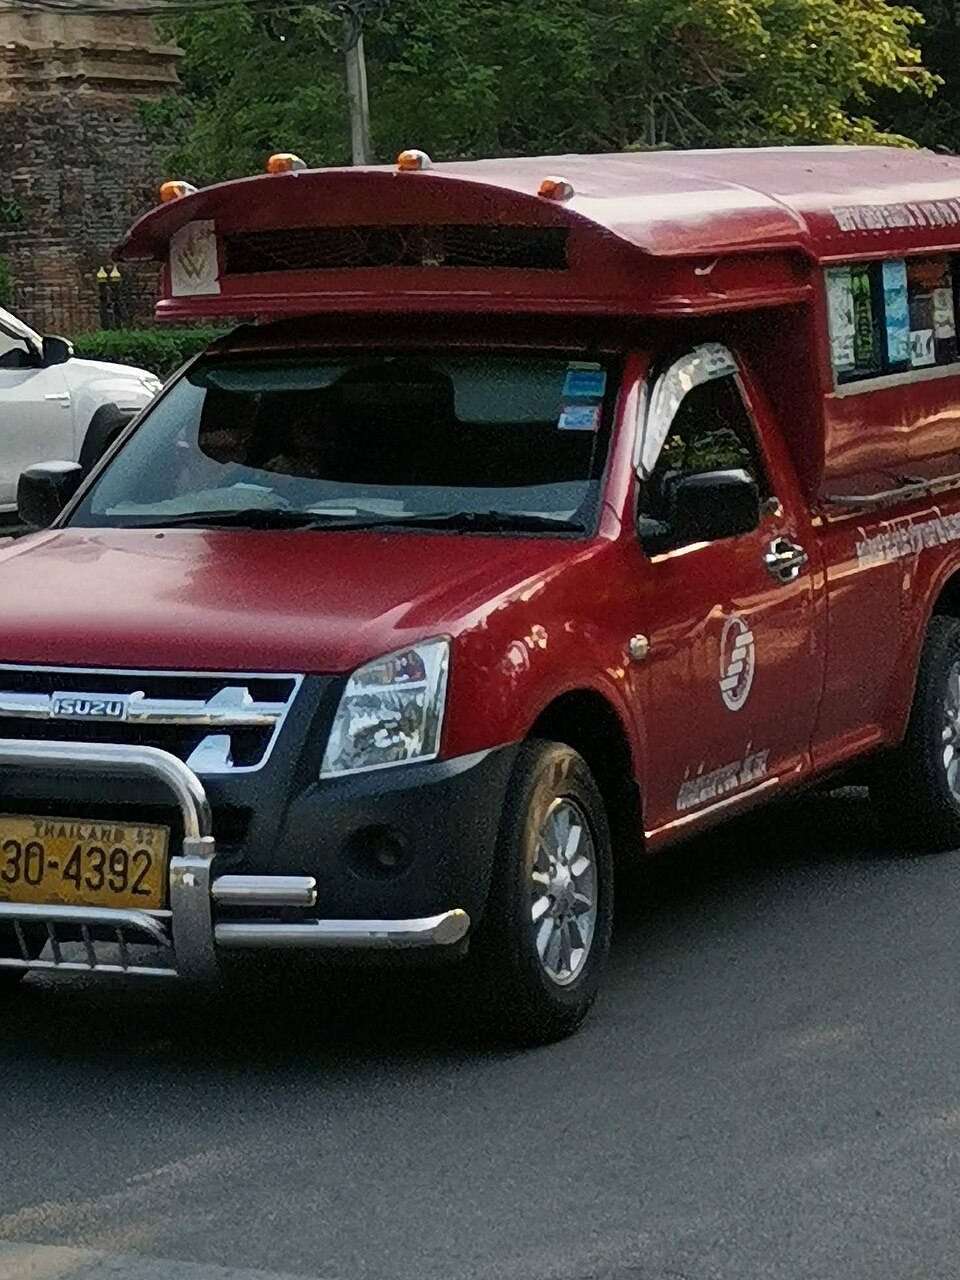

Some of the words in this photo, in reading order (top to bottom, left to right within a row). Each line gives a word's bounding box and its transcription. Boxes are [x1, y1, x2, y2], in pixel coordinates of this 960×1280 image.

[53, 699, 123, 717] ISUZU
[32, 821, 125, 844] THAILAND
[0, 839, 153, 897] 30-4392
